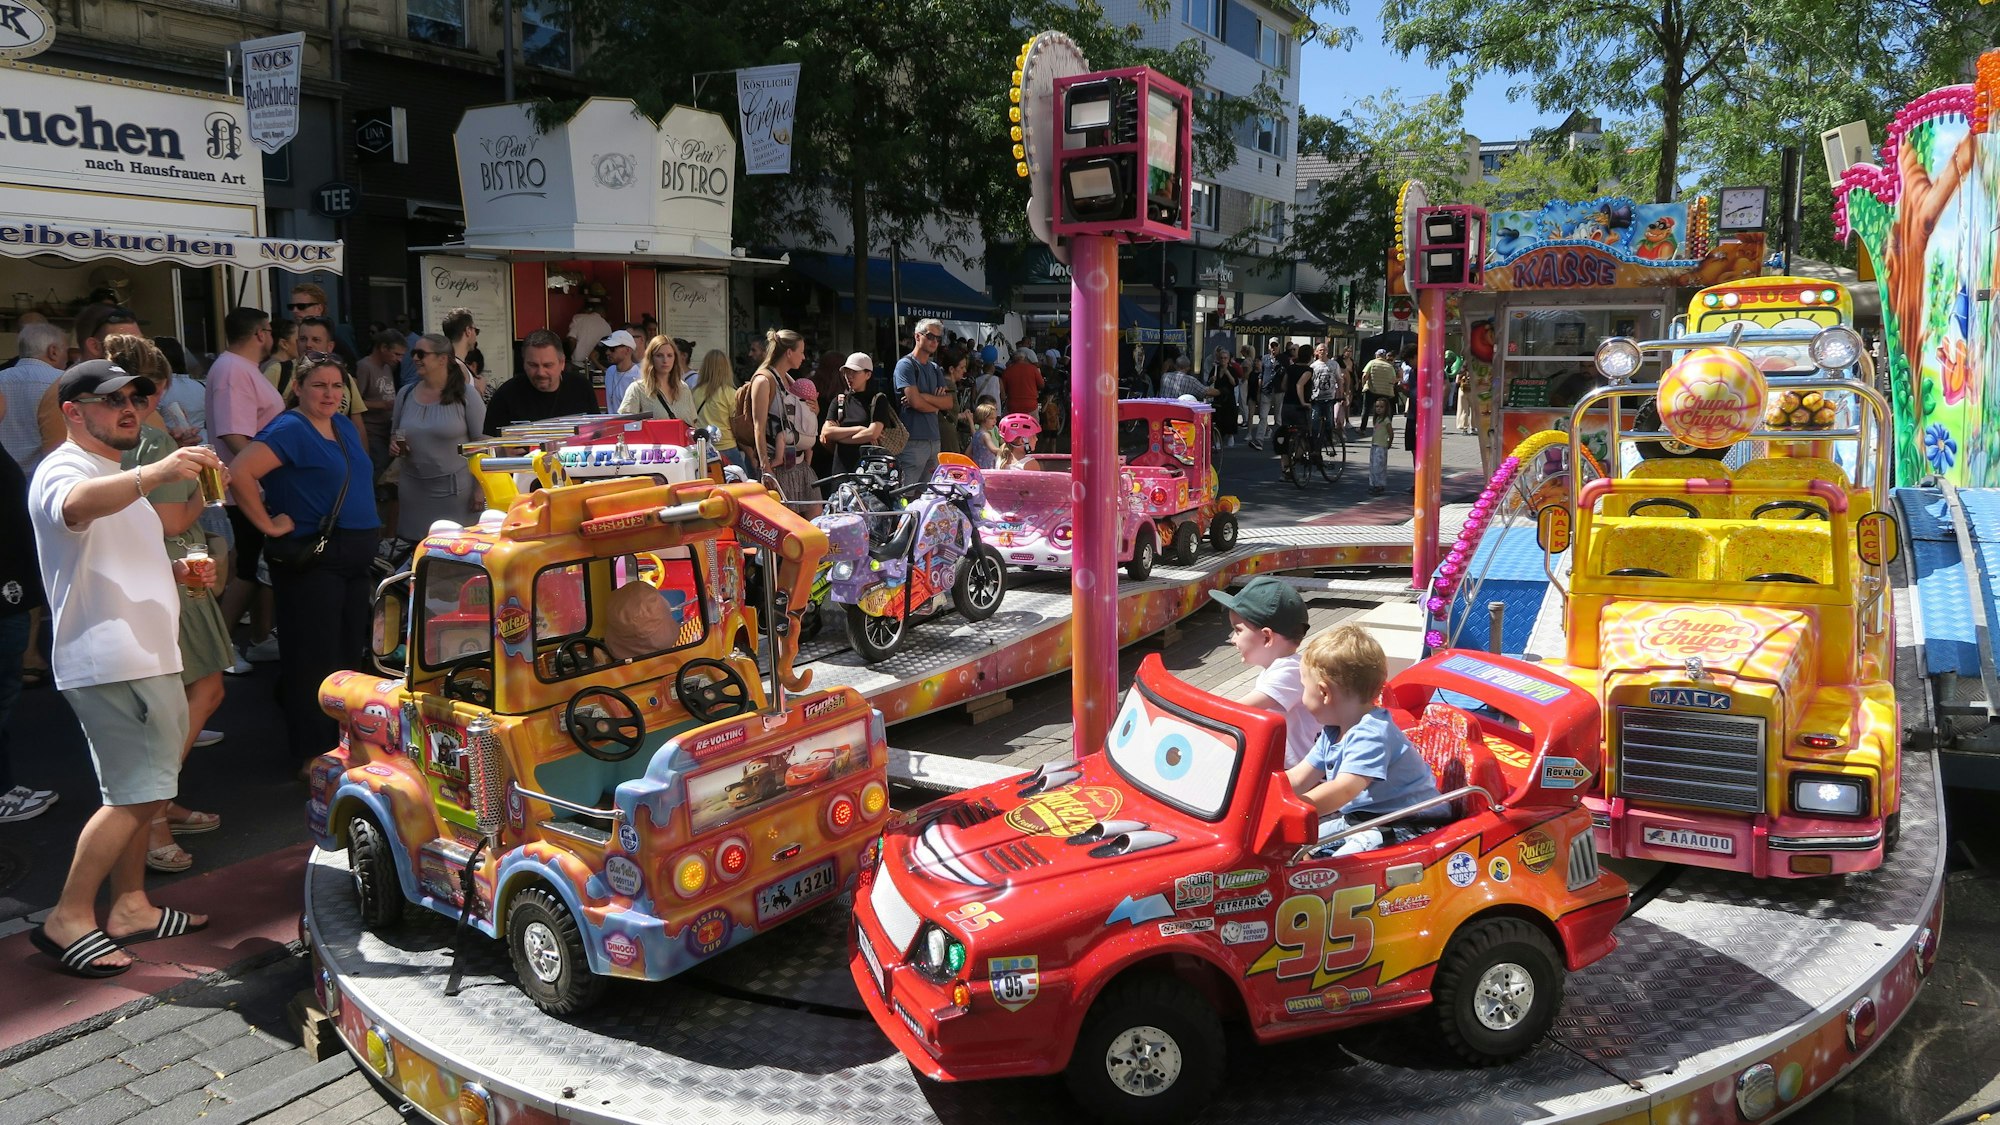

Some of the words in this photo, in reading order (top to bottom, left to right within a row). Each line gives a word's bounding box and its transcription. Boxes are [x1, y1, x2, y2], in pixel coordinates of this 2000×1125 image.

[252, 49, 293, 71] NOCK
[246, 79, 298, 110] Reibekuchen
[743, 79, 792, 90] KÖSTLICHE
[742, 89, 795, 140] Crêpes
[495, 135, 527, 158] Petit
[680, 139, 714, 163] Petit
[85, 159, 125, 173] nach
[130, 161, 216, 182] Hausfrauen
[221, 172, 246, 184] Art
[481, 158, 546, 191] BISTRO
[662, 160, 728, 196] BISTRO
[321, 189, 350, 211] TEE
[260, 242, 335, 263] NOCK
[1513, 252, 1618, 288] KASSE
[1740, 291, 1801, 304] BUS
[907, 306, 952, 319] Bücherwelt
[1683, 393, 1737, 414] Chupa
[1678, 409, 1733, 428] Chups
[640, 448, 680, 465] DEP.
[586, 515, 645, 535] RESCUE
[741, 512, 753, 527] No
[752, 519, 779, 542] Stall
[1553, 509, 1568, 548] MACK
[474, 543, 491, 551] CUP
[1861, 518, 1879, 560] MACK
[1657, 618, 1747, 640] Chupa
[1650, 631, 1741, 651] Chups
[1652, 689, 1727, 709] MACK
[793, 867, 833, 897] 432U
[1294, 871, 1333, 884] SHIFTY
[1177, 881, 1211, 900] Stop
[1215, 897, 1256, 911] RETREAD
[691, 910, 727, 933] PISTON
[945, 902, 1004, 932] 95
[1275, 884, 1376, 979] 95
[607, 942, 636, 955] DINOCO
[702, 939, 722, 954] CUP
[1004, 975, 1023, 998] 95
[1288, 997, 1322, 1010] PISTON
[1351, 990, 1369, 1002] CUP
